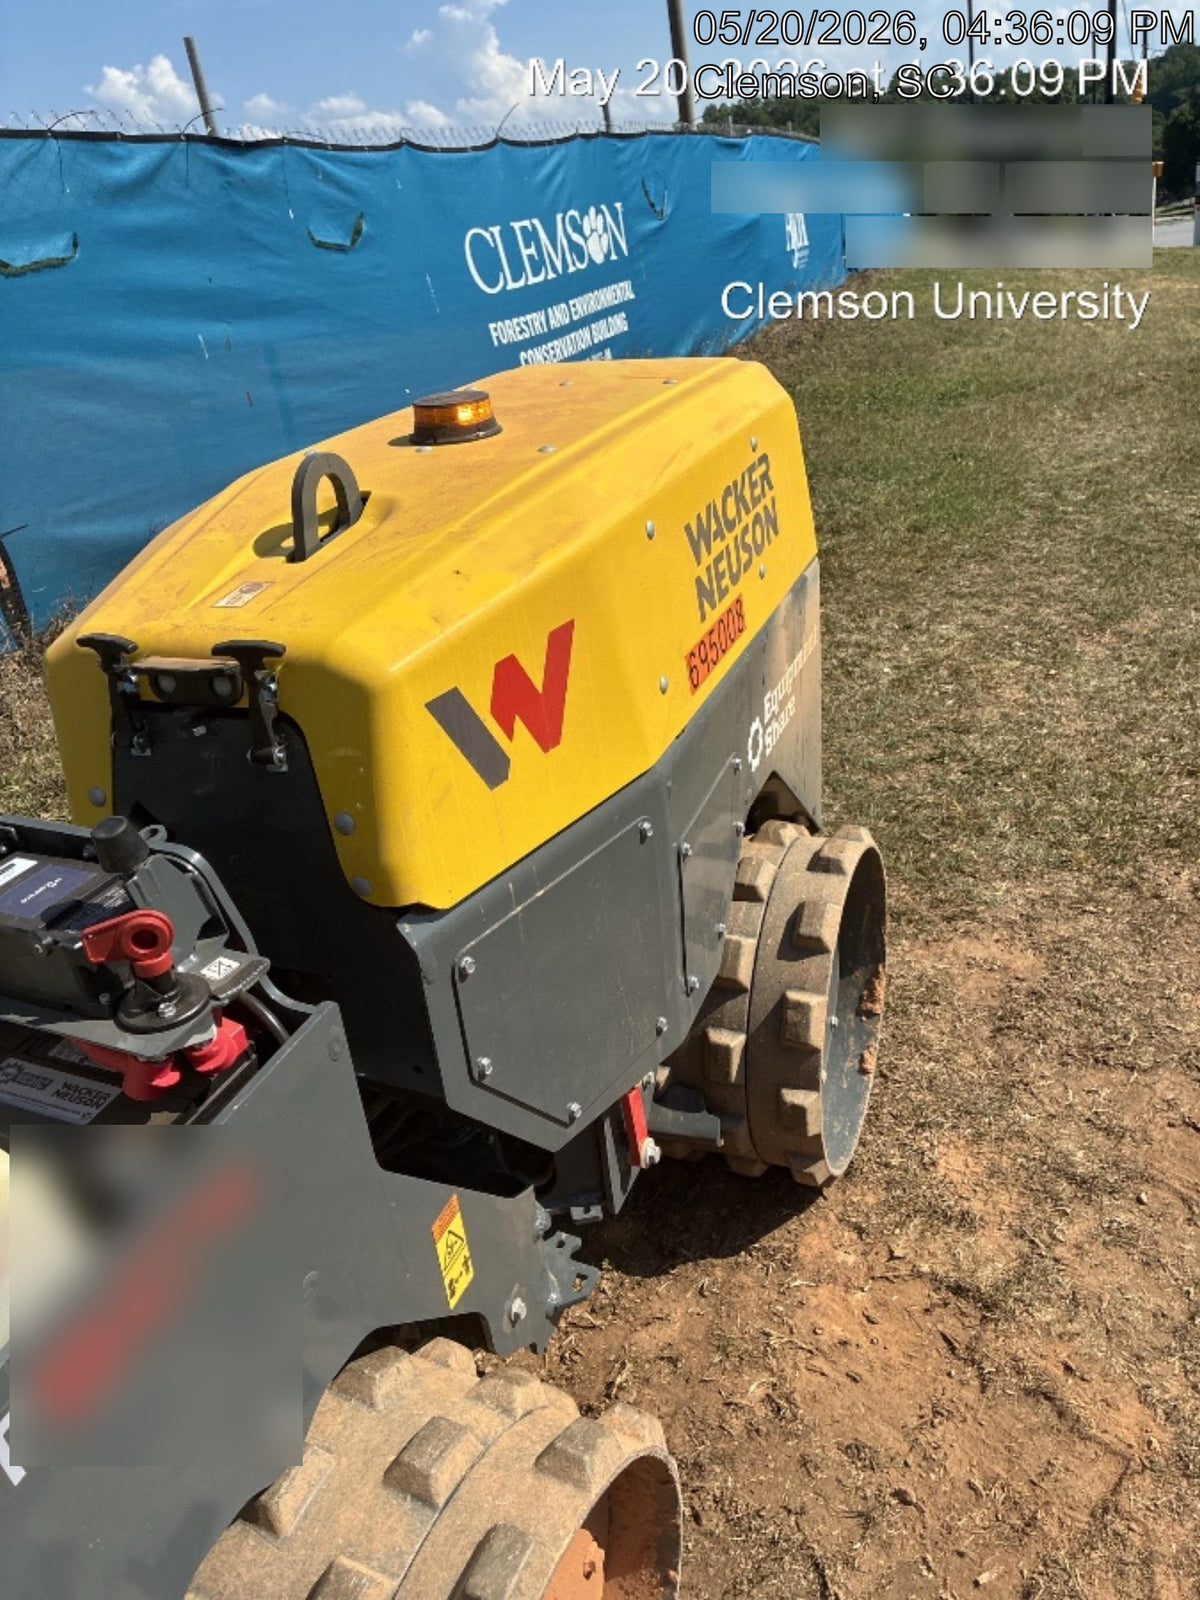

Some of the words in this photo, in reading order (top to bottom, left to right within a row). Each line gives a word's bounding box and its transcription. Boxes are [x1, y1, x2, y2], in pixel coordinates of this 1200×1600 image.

[488, 308, 549, 347] FORESTRY
[548, 302, 570, 330] AND
[568, 280, 636, 320] ENVIRONMENTAL
[519, 325, 593, 367] CONSERVATION
[590, 311, 629, 344] BUILDING
[684, 453, 775, 567] WACKER
[694, 496, 779, 624] NEUSON
[688, 598, 744, 690] 695008
